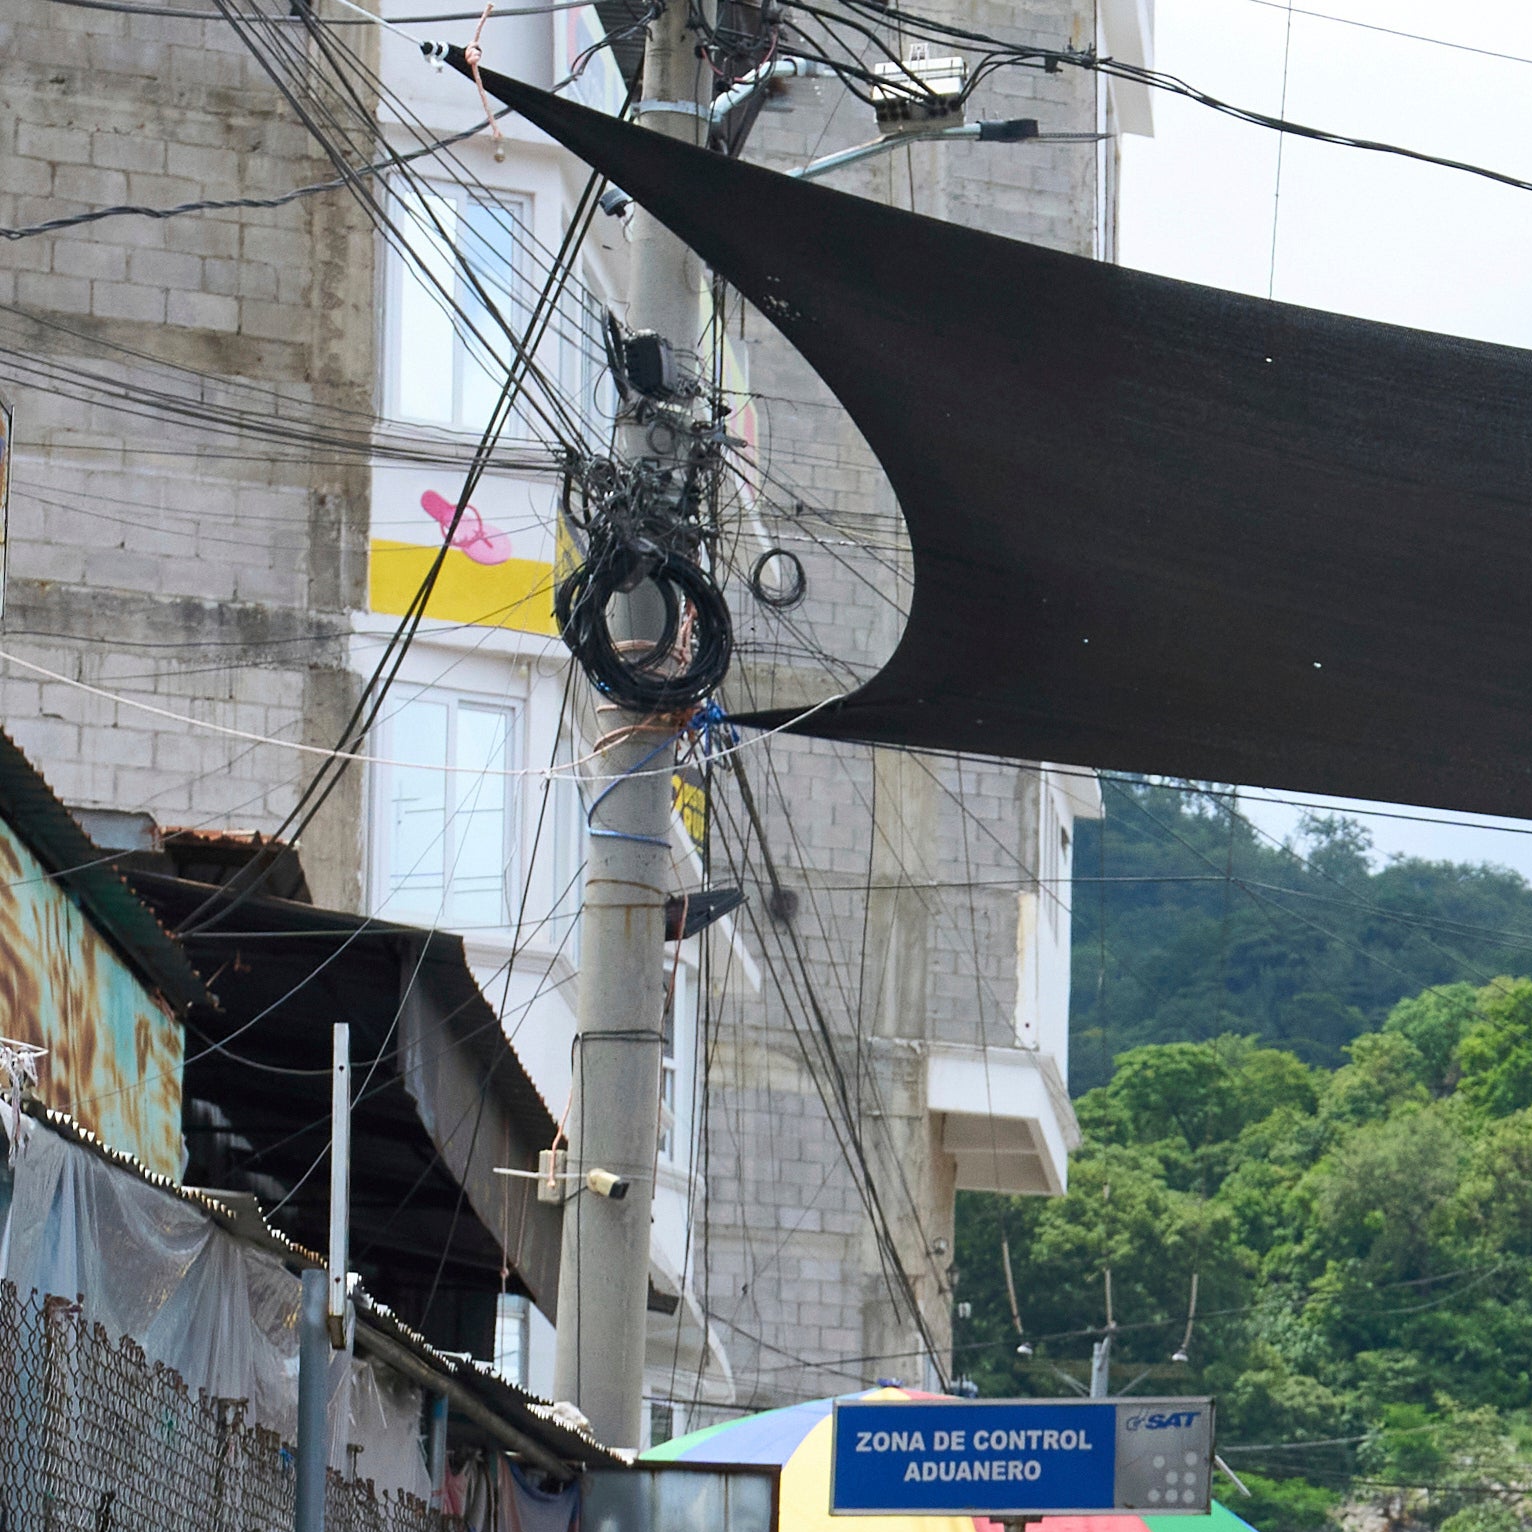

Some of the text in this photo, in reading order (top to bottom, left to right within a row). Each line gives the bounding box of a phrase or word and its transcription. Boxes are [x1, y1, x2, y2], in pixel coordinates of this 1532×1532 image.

[1143, 1411, 1201, 1430] SAT
[855, 1429, 1093, 1453] ZONA DE CONTROL
[903, 1461, 1042, 1482] ADUANERO
